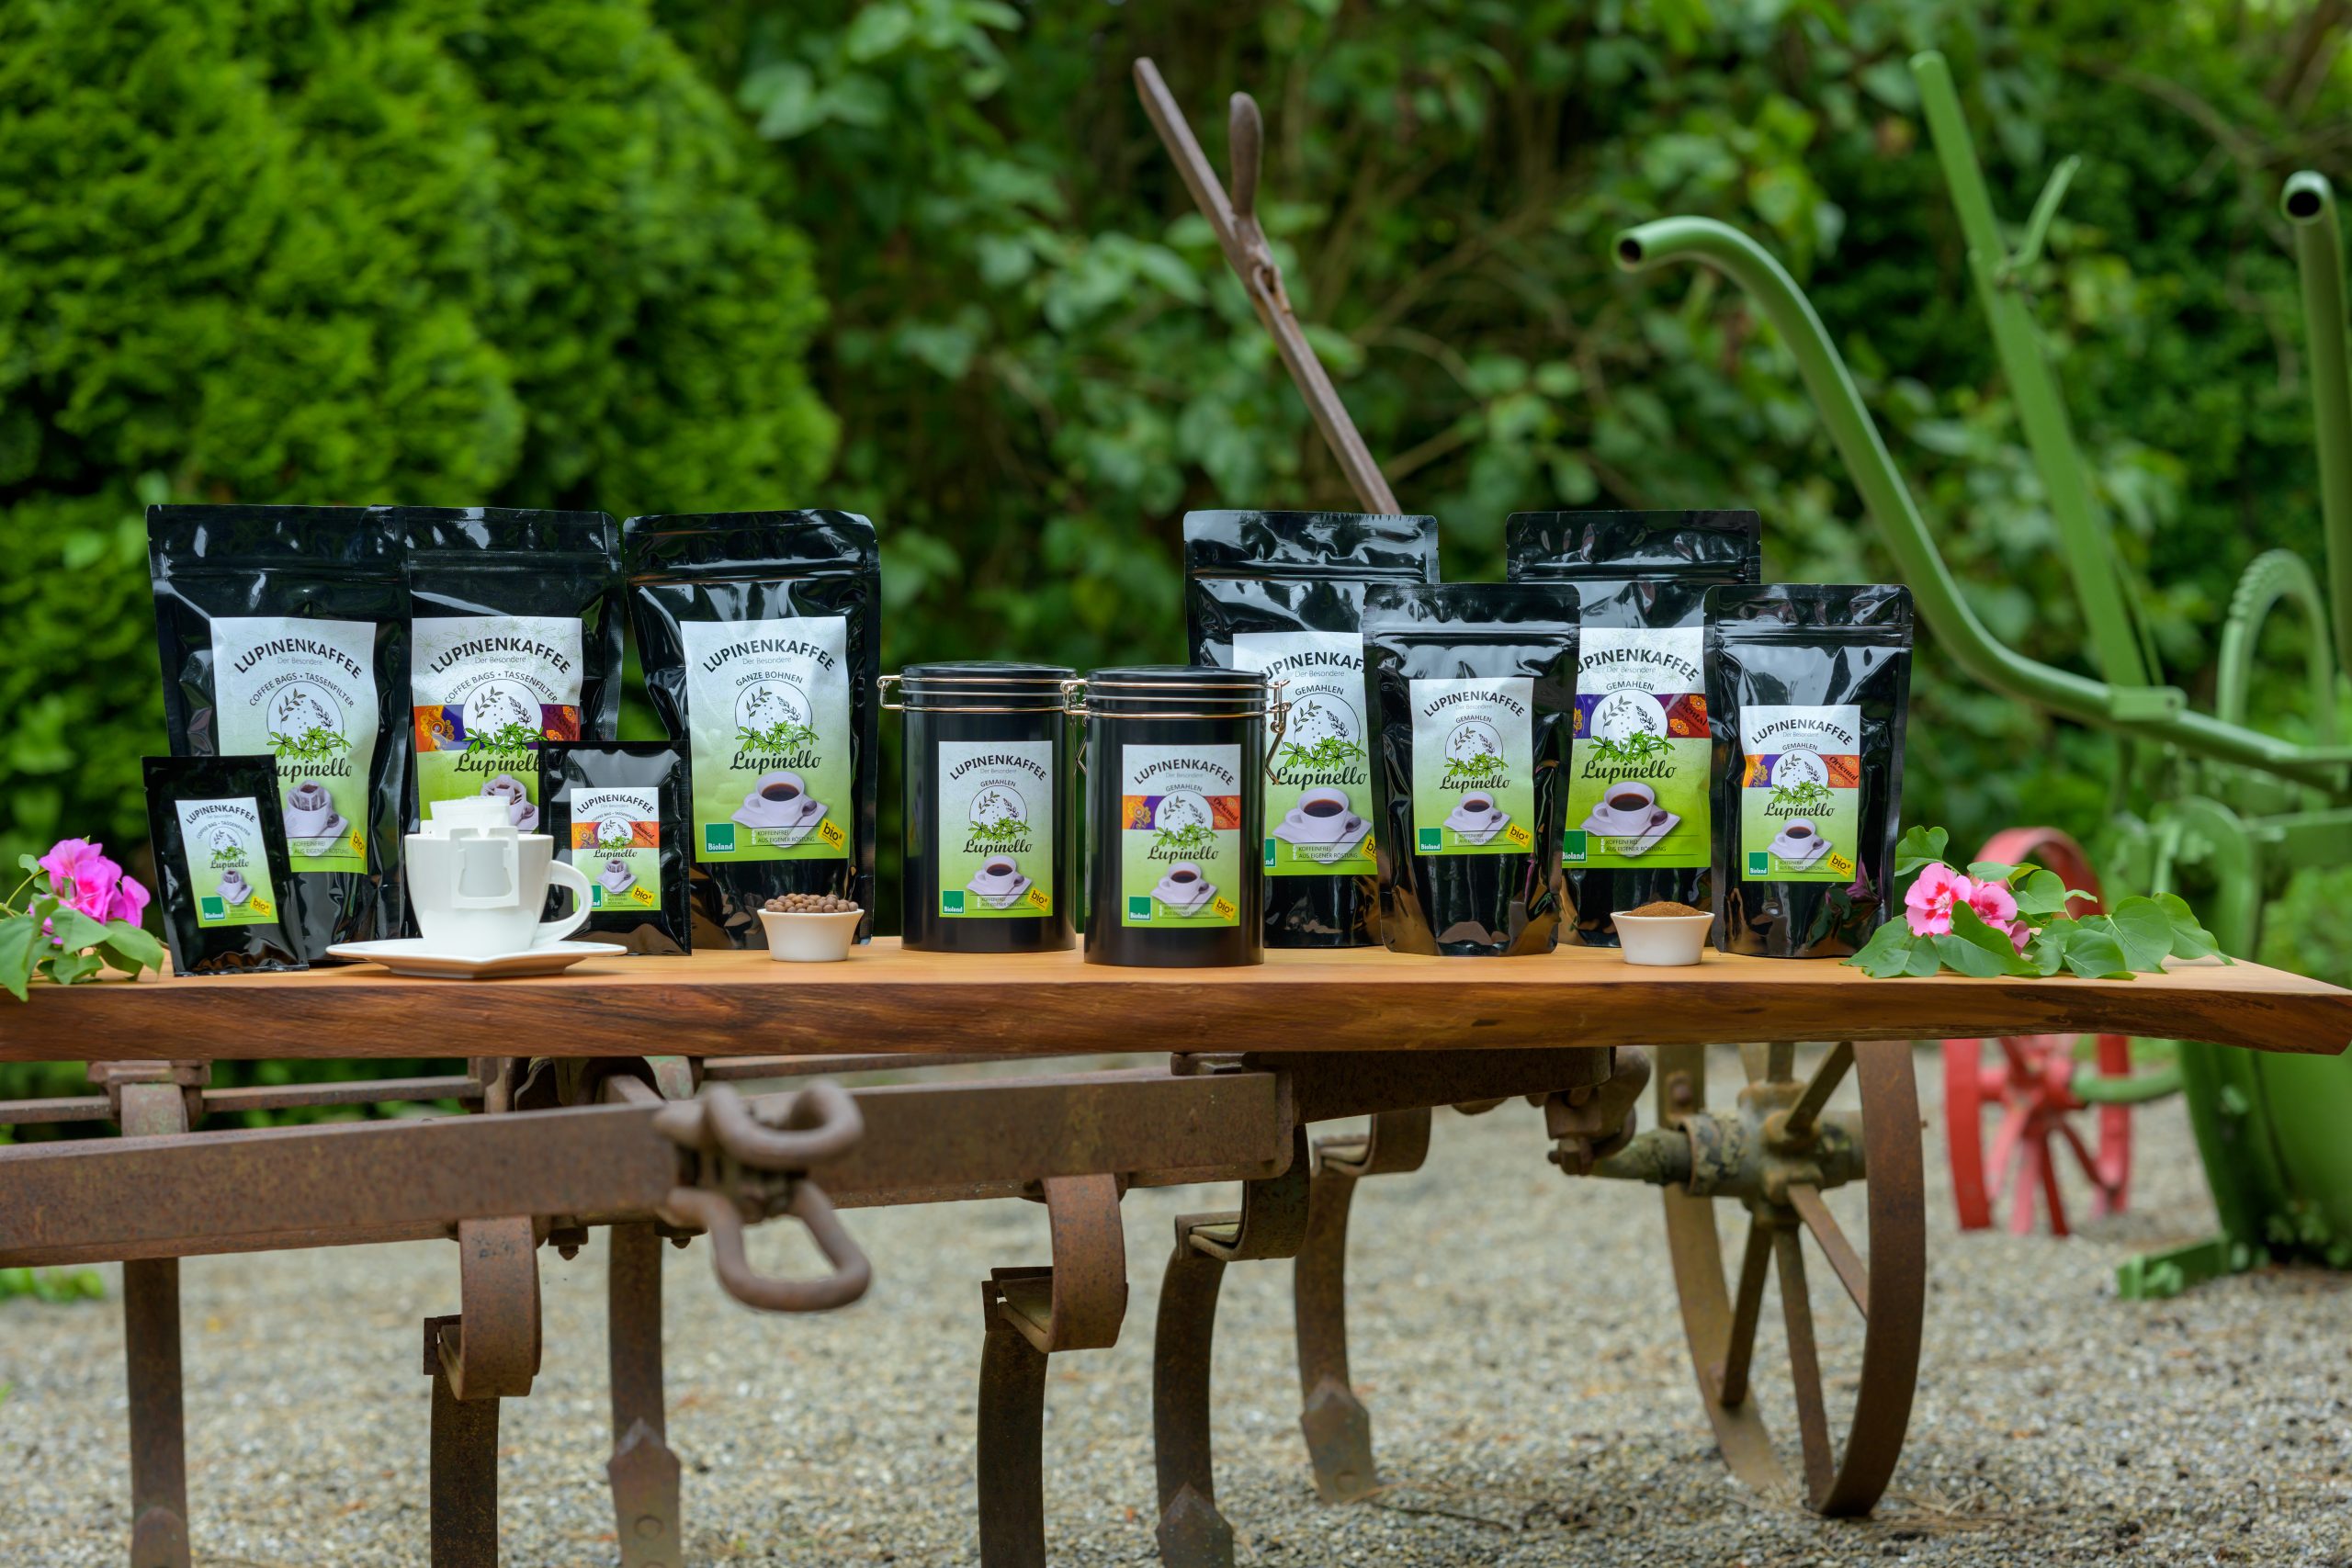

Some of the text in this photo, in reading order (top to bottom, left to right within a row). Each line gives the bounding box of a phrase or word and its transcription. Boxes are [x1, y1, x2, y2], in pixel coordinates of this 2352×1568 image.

[233, 638, 362, 679] LUPINENKAFFEE
[291, 657, 323, 665] Besondere
[430, 637, 571, 674] LUPINENKAFFEE
[703, 638, 835, 673] LUPINENKAFFEE
[1577, 649, 1700, 682] UPINENKAFFEE
[249, 672, 355, 707] COFFEE BAGS TASSENFILTER
[445, 671, 559, 705] COFFEE BAGS TASSENFILTER
[736, 671, 803, 687] GANZE BOHNEN
[1295, 684, 1344, 696] GEMAHLEN
[1606, 681, 1655, 691] GEMAHLEN
[1424, 691, 1525, 717] LUPINENKAFFEE
[1455, 716, 1492, 724] GEMAHLEN
[1751, 719, 1853, 746] LUPINENKAFFEE
[1782, 743, 1818, 751] GEMAHLEN
[277, 757, 353, 783] upinello
[454, 752, 539, 777] Lupinell
[729, 750, 822, 775] Lupinello
[949, 754, 1046, 781] LUPINENKAFFEE
[1134, 759, 1235, 786] LUPINENKAFFEE
[1581, 760, 1677, 784] Lupinello
[1829, 756, 1859, 781] Oriental
[1272, 766, 1368, 791] Lupinello
[1440, 774, 1511, 793] Lupinello
[186, 805, 256, 825] LUPINENKAFFEE
[577, 794, 654, 814] LUPINENKAFFEE
[1213, 797, 1238, 822] Oriental
[1764, 802, 1836, 820] Lupinello
[593, 849, 638, 860] Lupinello
[707, 842, 733, 851] Bioland
[963, 839, 1033, 857] Lupinello
[1148, 845, 1220, 864] Lupinello
[1366, 839, 1376, 853] bi
[1562, 852, 1585, 860] Bioland
[209, 859, 249, 871] Lupinello
